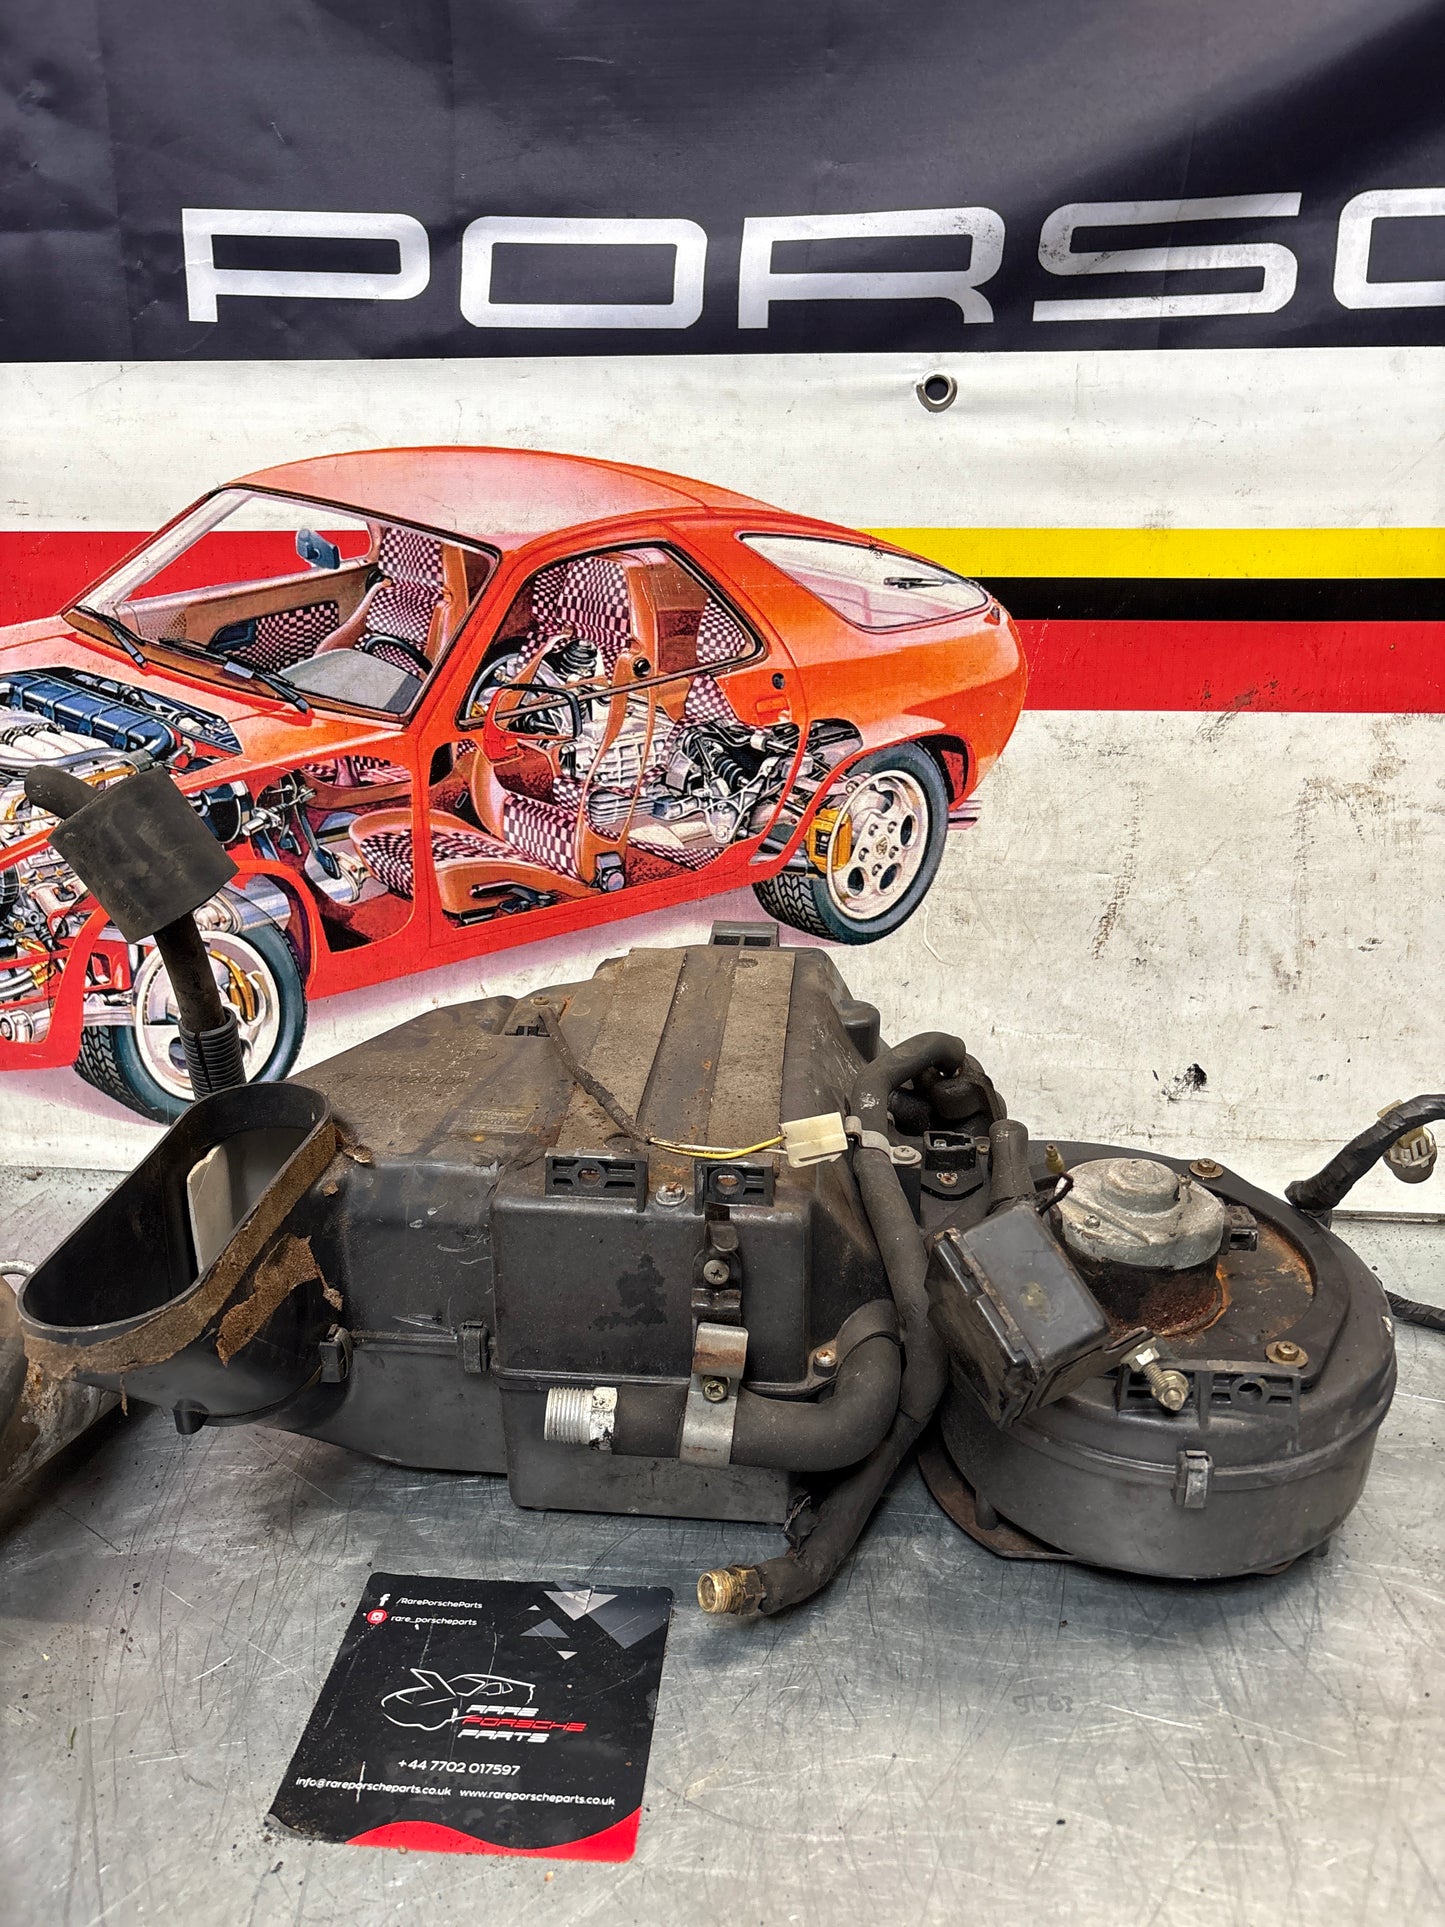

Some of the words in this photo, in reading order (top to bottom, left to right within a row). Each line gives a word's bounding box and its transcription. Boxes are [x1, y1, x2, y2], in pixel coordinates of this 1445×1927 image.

[391, 1615, 478, 1626] rare_porscheparts
[466, 1704, 539, 1717] RARE
[462, 1715, 587, 1732] PORSCHE
[457, 1729, 550, 1743] PARTS
[398, 1759, 427, 1771] +44
[430, 1761, 467, 1774] 7702
[468, 1763, 520, 1776] 017597
[295, 1776, 452, 1797] info@rareporscheparts.co.uk
[459, 1788, 616, 1807] www.rareporscheparts.co.uk
